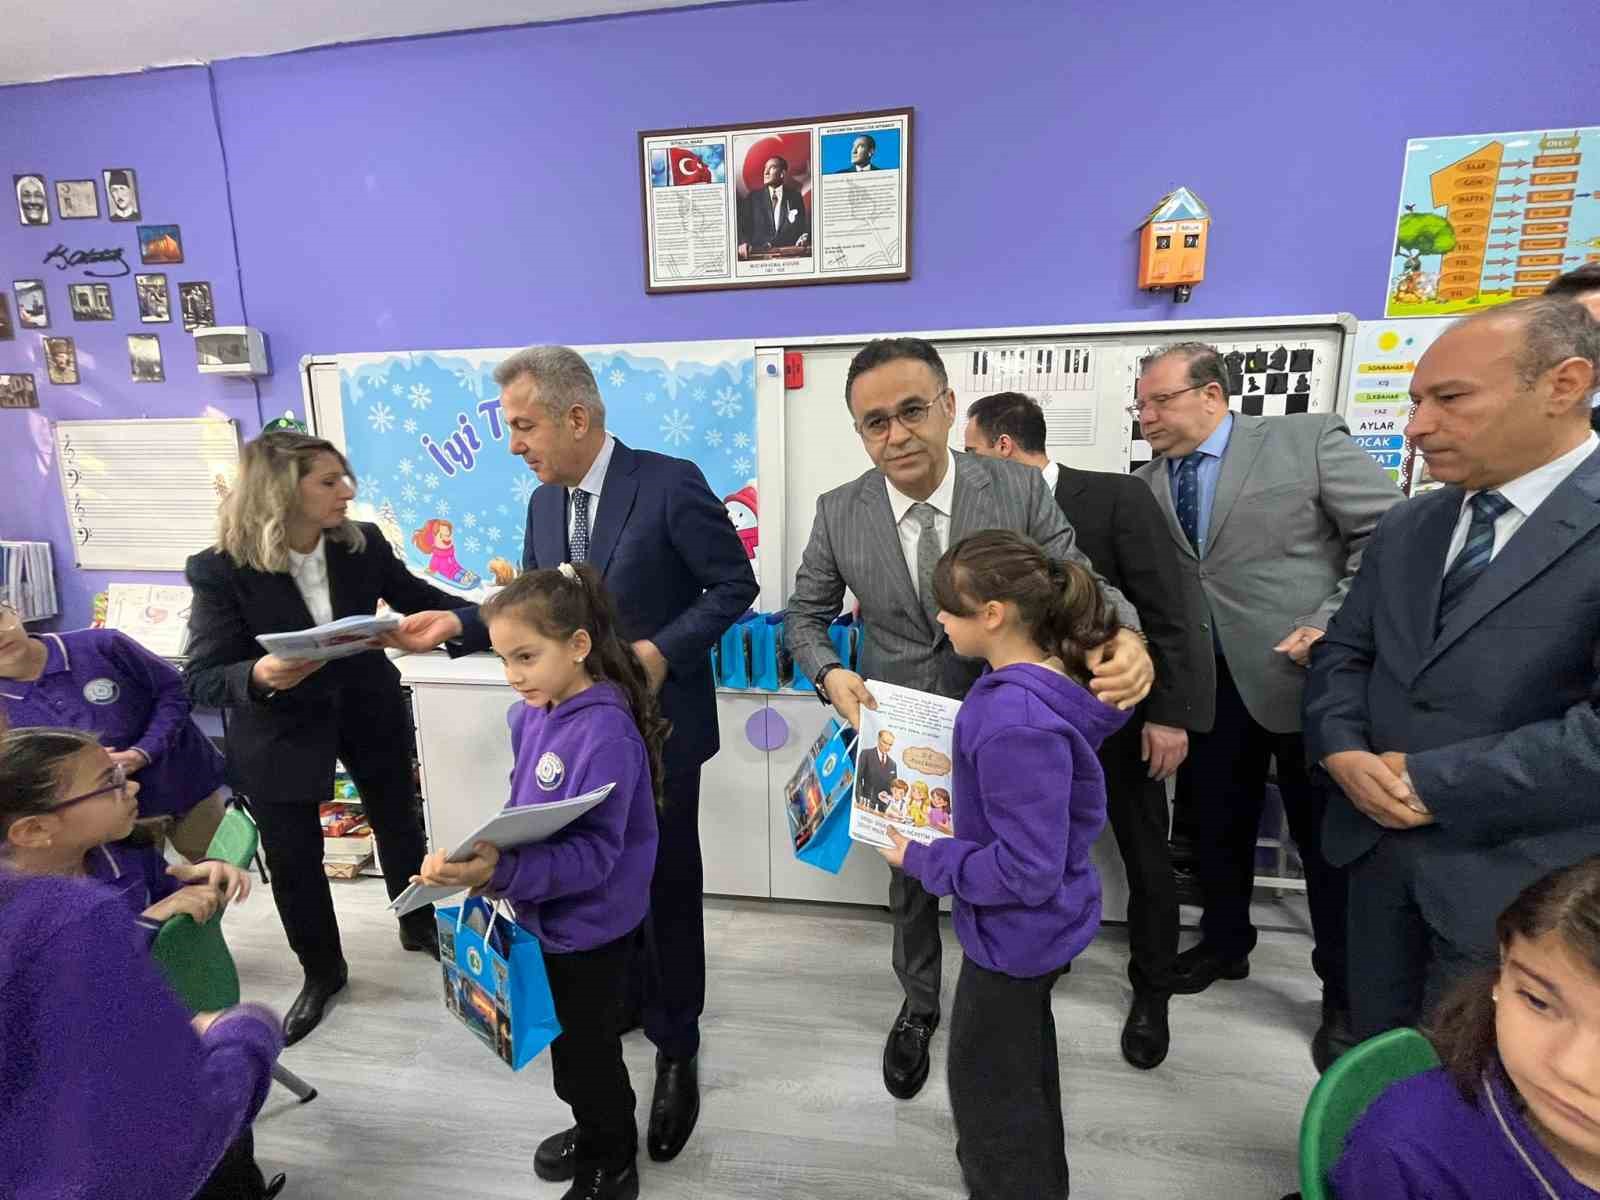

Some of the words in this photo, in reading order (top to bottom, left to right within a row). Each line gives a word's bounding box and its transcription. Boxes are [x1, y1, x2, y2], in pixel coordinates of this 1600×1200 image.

[421, 414, 481, 475] İyi
[478, 399, 503, 439] T
[1360, 421, 1394, 431] AYLAR
